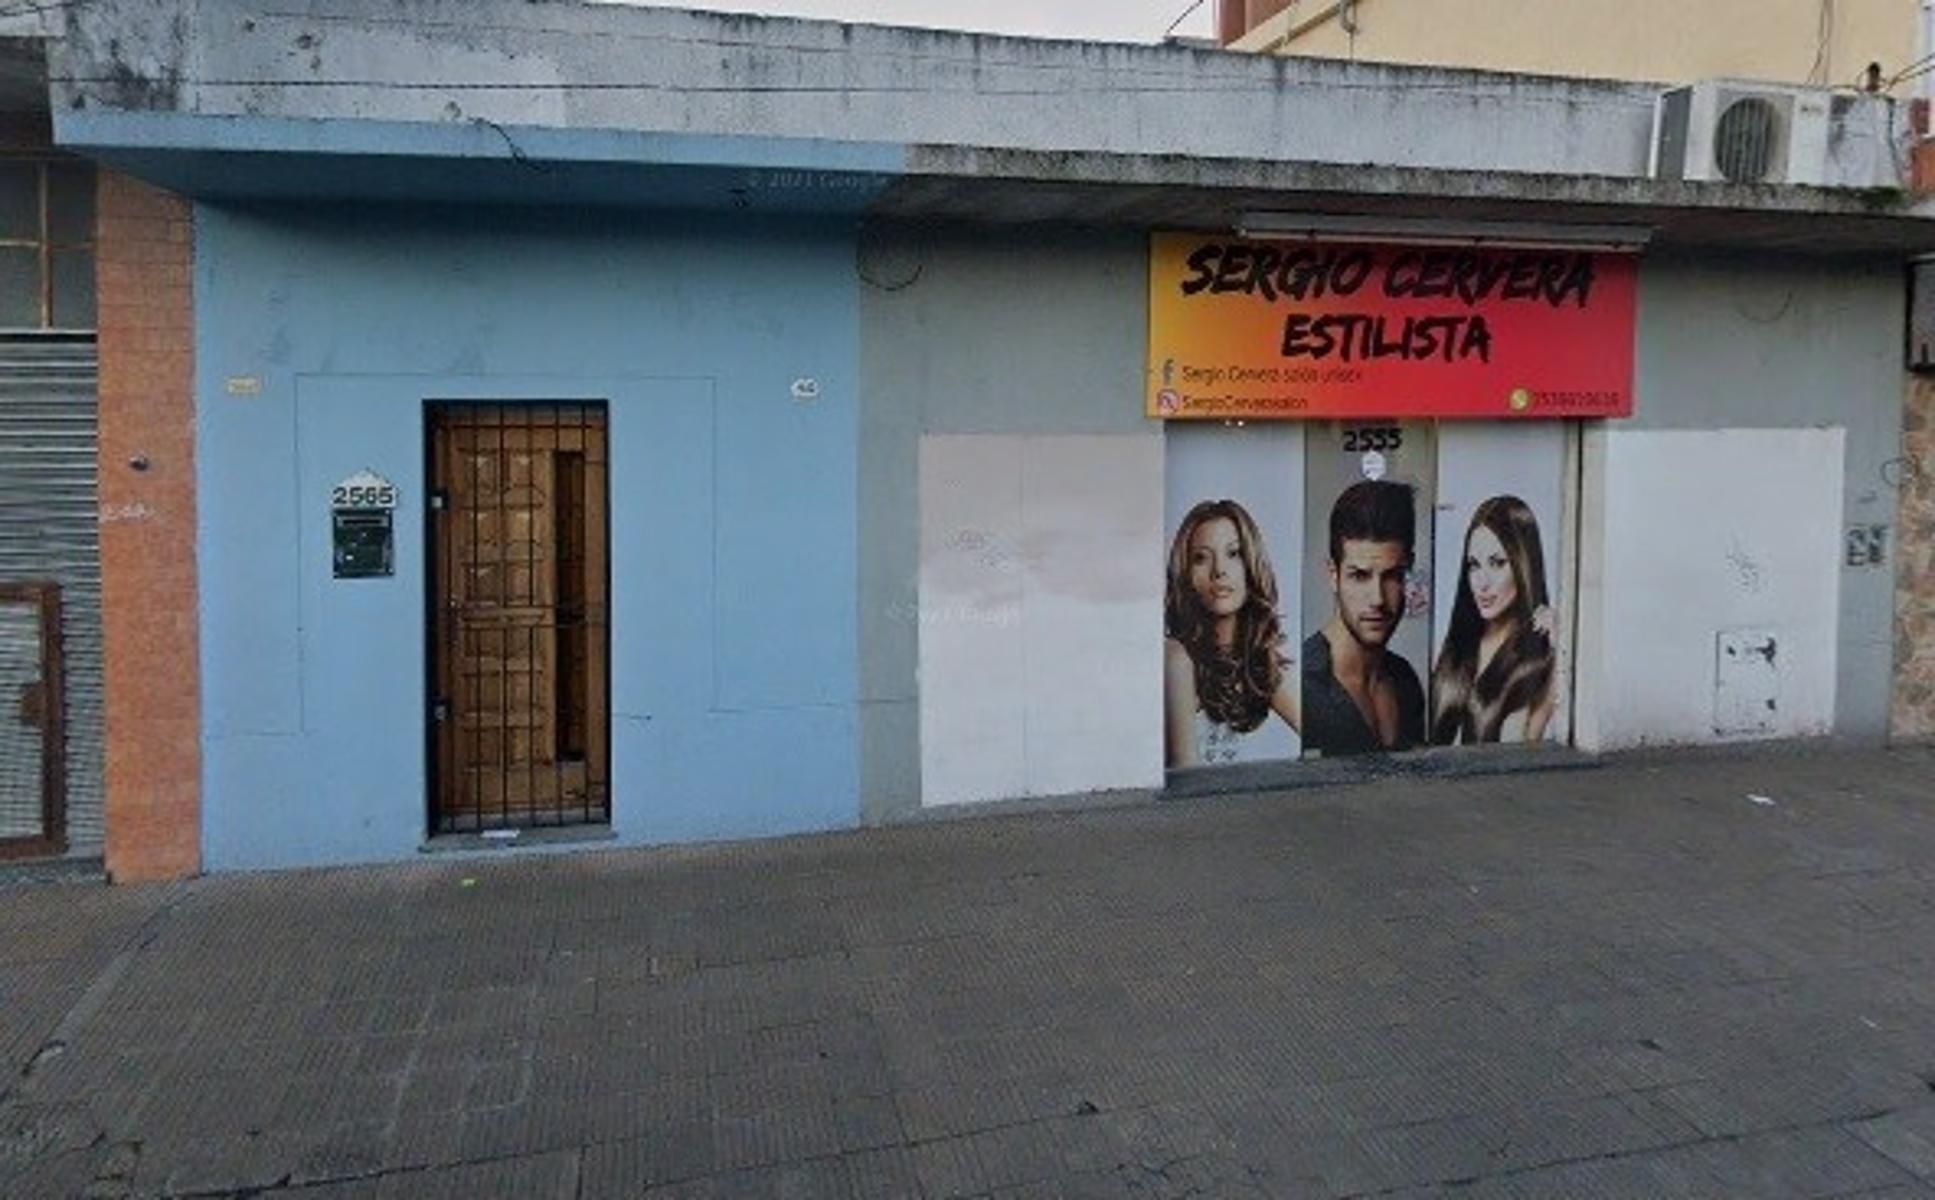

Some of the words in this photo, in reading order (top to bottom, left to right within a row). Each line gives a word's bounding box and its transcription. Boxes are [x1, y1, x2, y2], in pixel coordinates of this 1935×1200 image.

[1181, 243, 1377, 305] SERGIO
[1383, 248, 1596, 308] CERVERA
[1281, 313, 1491, 363] ESTILISTA
[1182, 366, 1226, 386] Sergio
[1343, 428, 1402, 452] 2555
[333, 486, 393, 504] 2565
